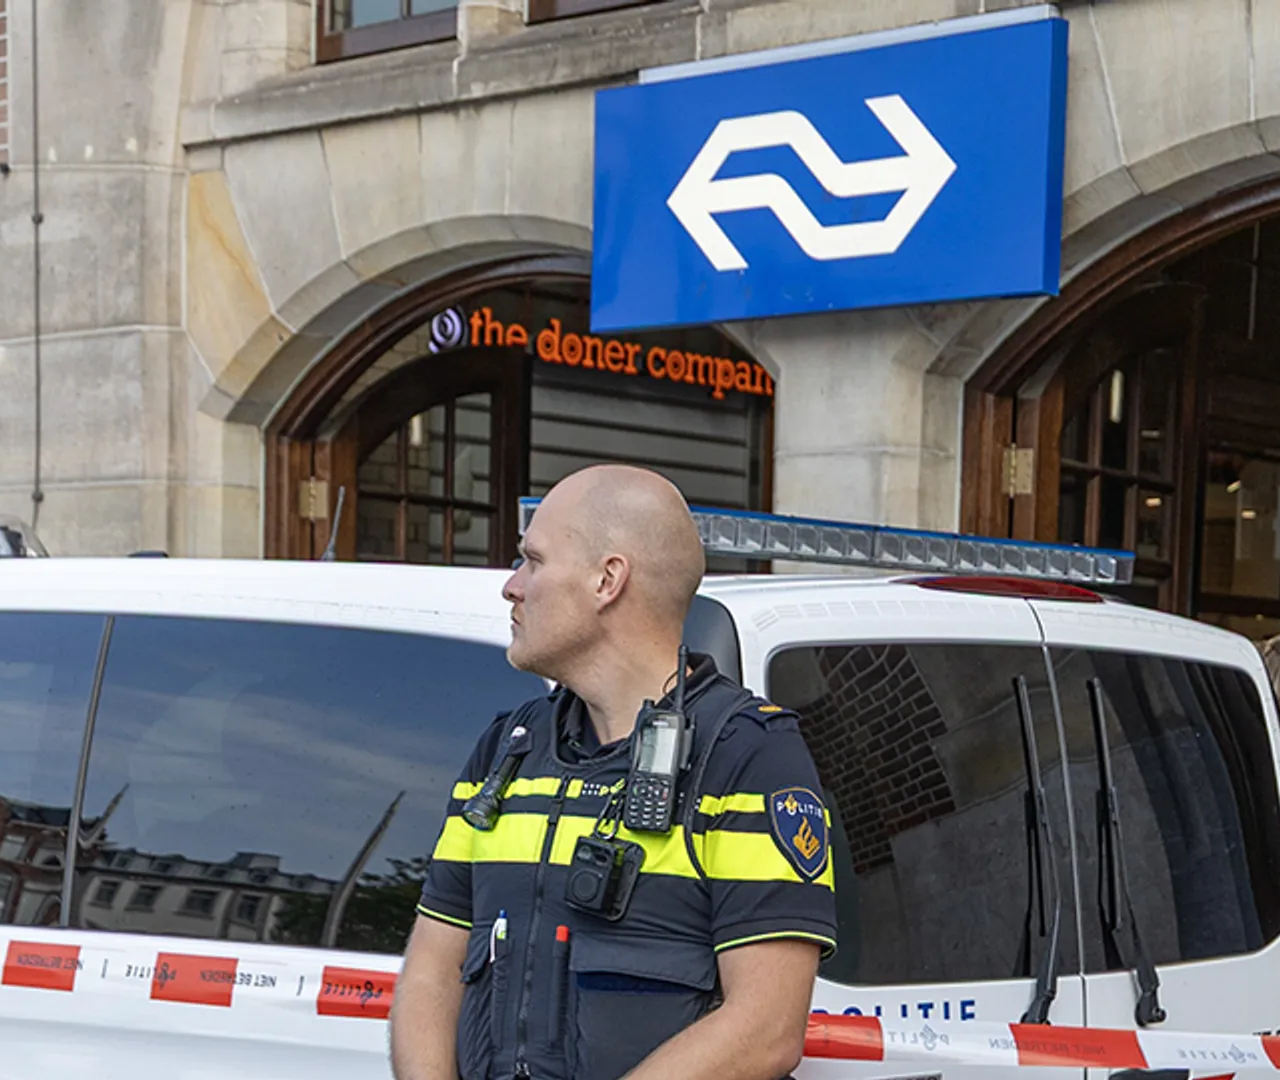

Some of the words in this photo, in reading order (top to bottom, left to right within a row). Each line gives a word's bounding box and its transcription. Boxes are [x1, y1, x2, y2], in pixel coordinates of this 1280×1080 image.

[470, 307, 528, 347] the
[536, 318, 641, 376] doner
[254, 974, 277, 989] NIET
